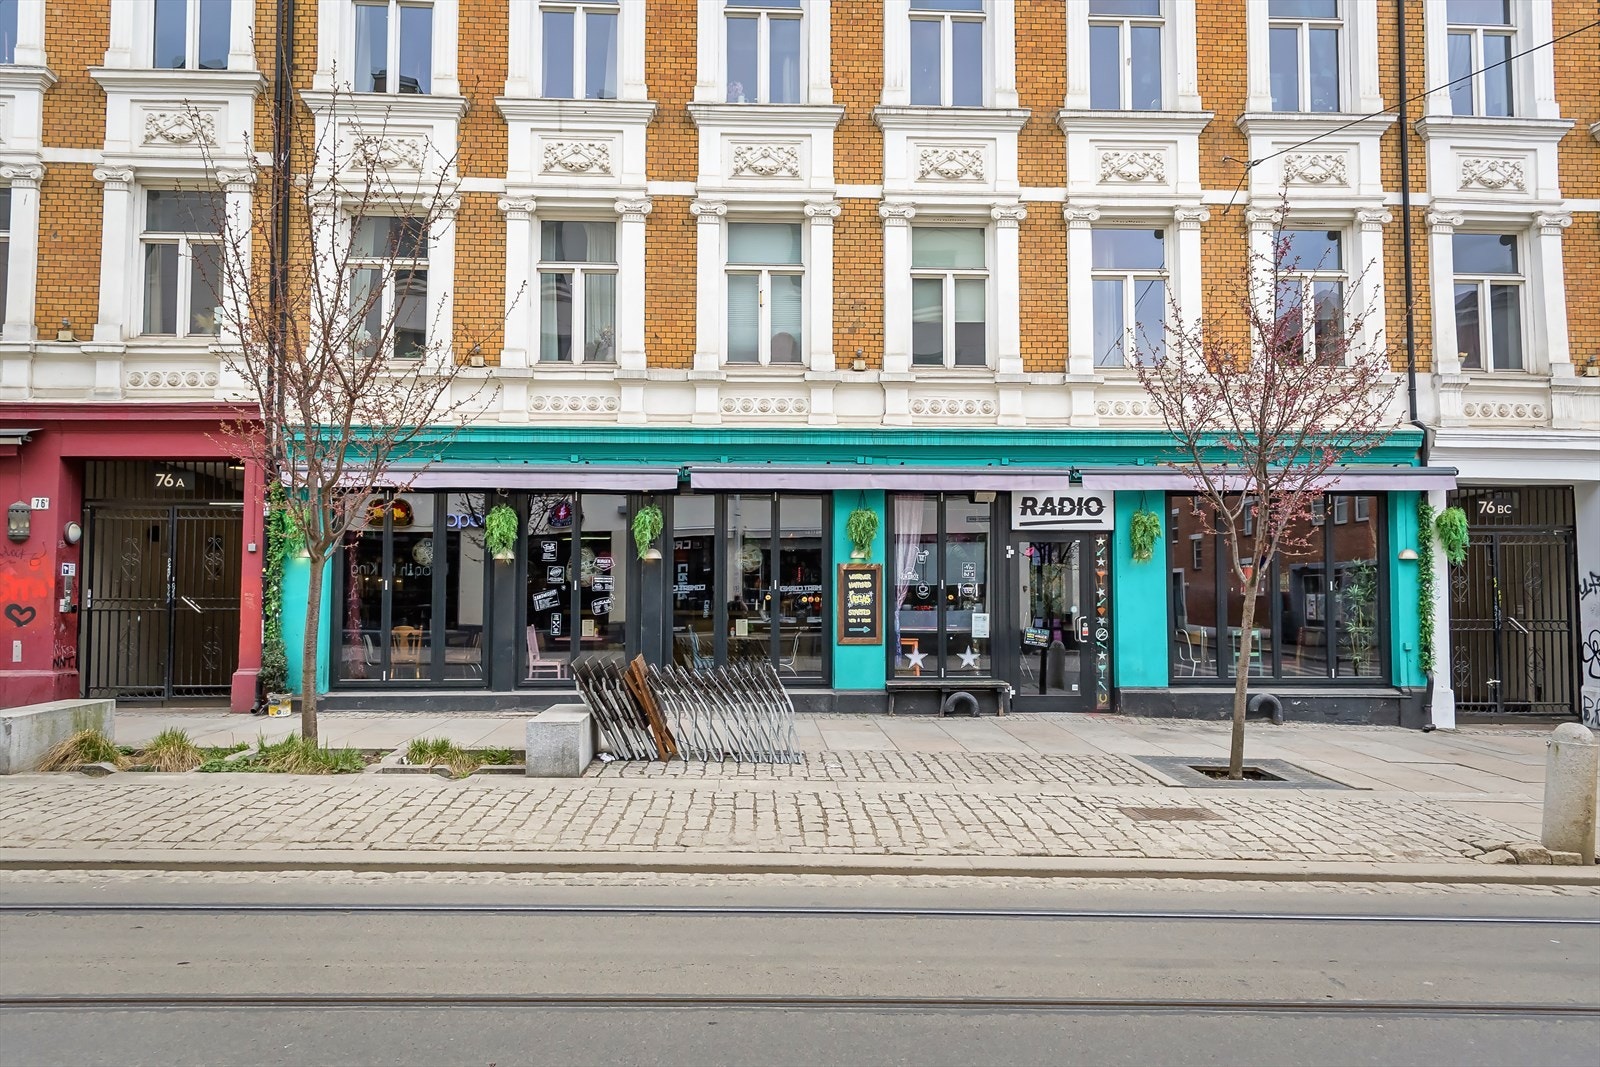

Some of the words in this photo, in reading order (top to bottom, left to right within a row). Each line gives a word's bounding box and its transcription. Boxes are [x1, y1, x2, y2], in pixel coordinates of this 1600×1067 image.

[155, 473, 174, 487] 76
[176, 478, 184, 487] A
[1018, 496, 1107, 516] RADIO
[1478, 501, 1495, 514] 76
[1497, 504, 1512, 514] BC
